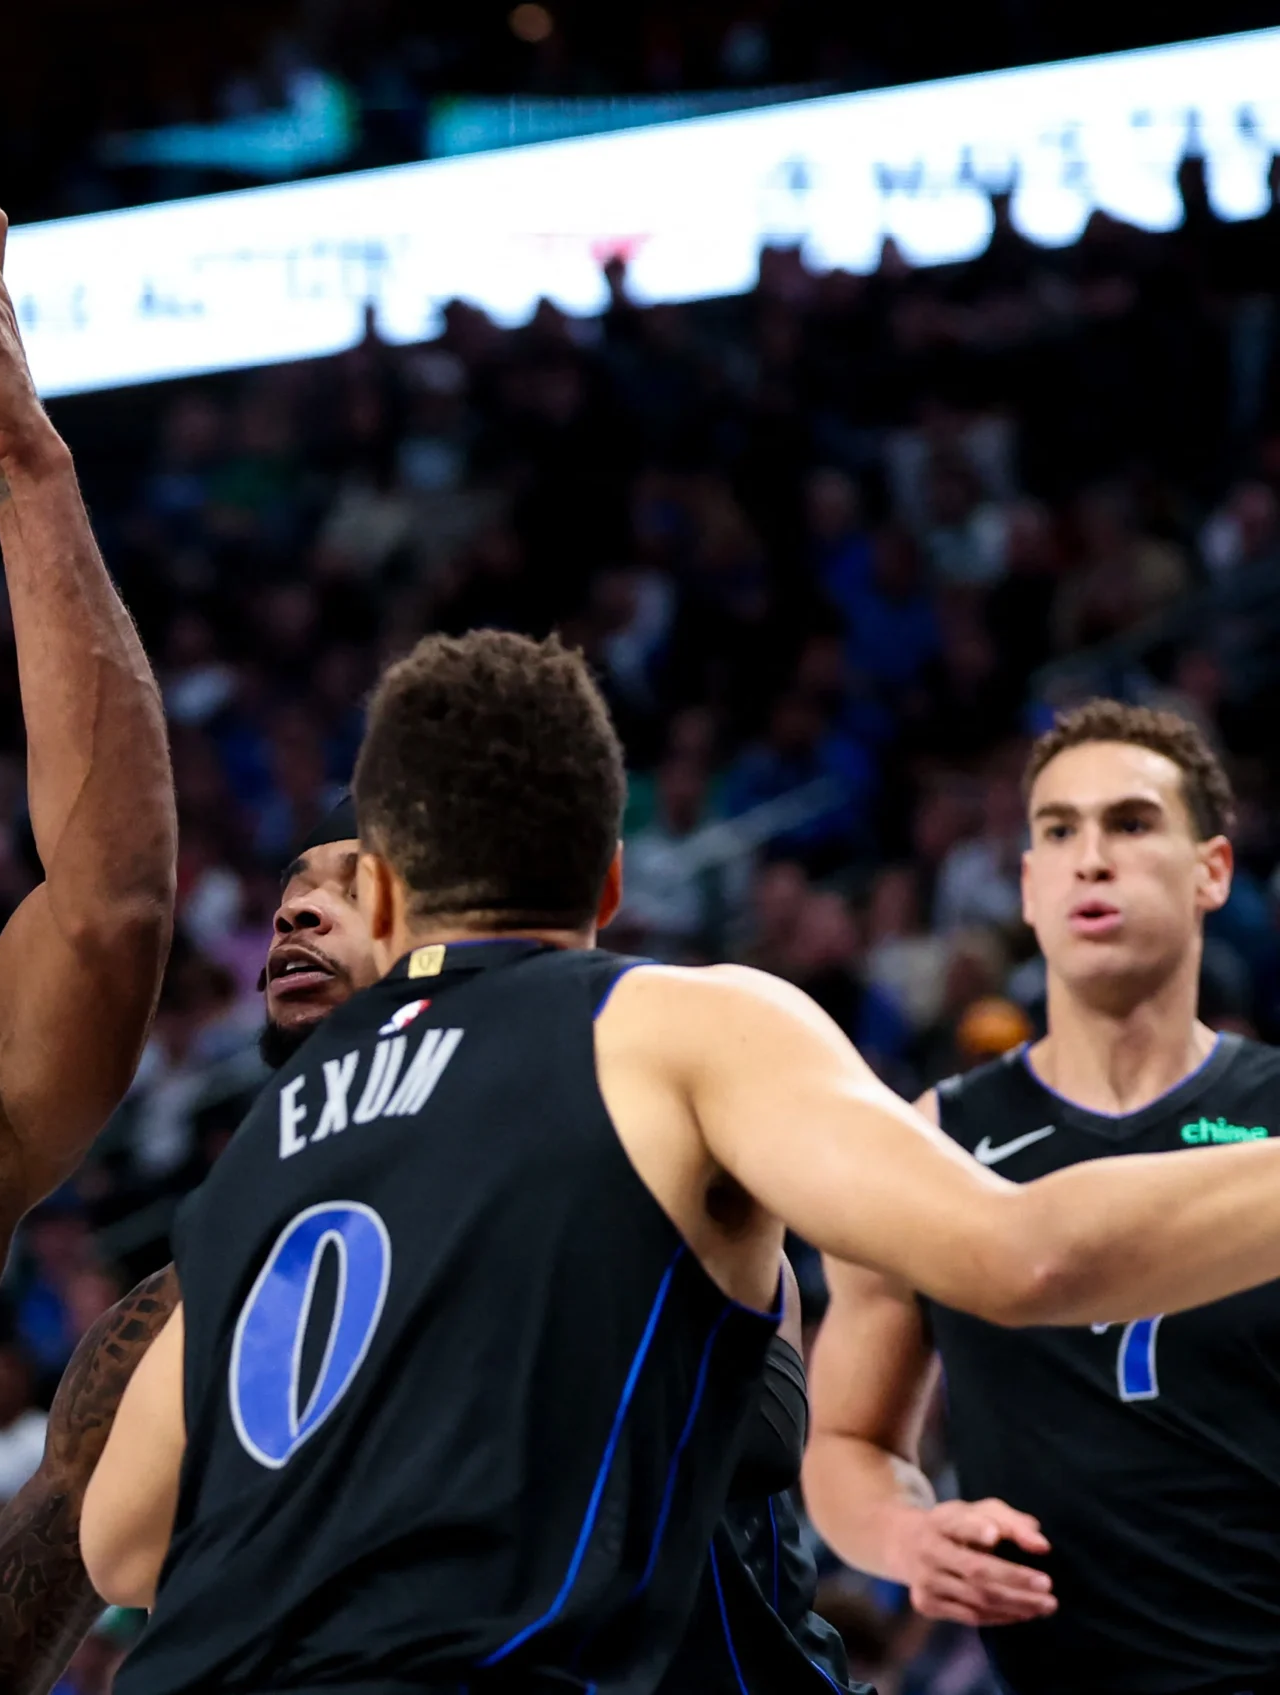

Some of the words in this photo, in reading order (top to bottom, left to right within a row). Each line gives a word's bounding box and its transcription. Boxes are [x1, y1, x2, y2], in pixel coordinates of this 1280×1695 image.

[278, 1027, 465, 1160] EXUM
[1180, 1116, 1269, 1144] chime
[228, 1200, 393, 1471] 0
